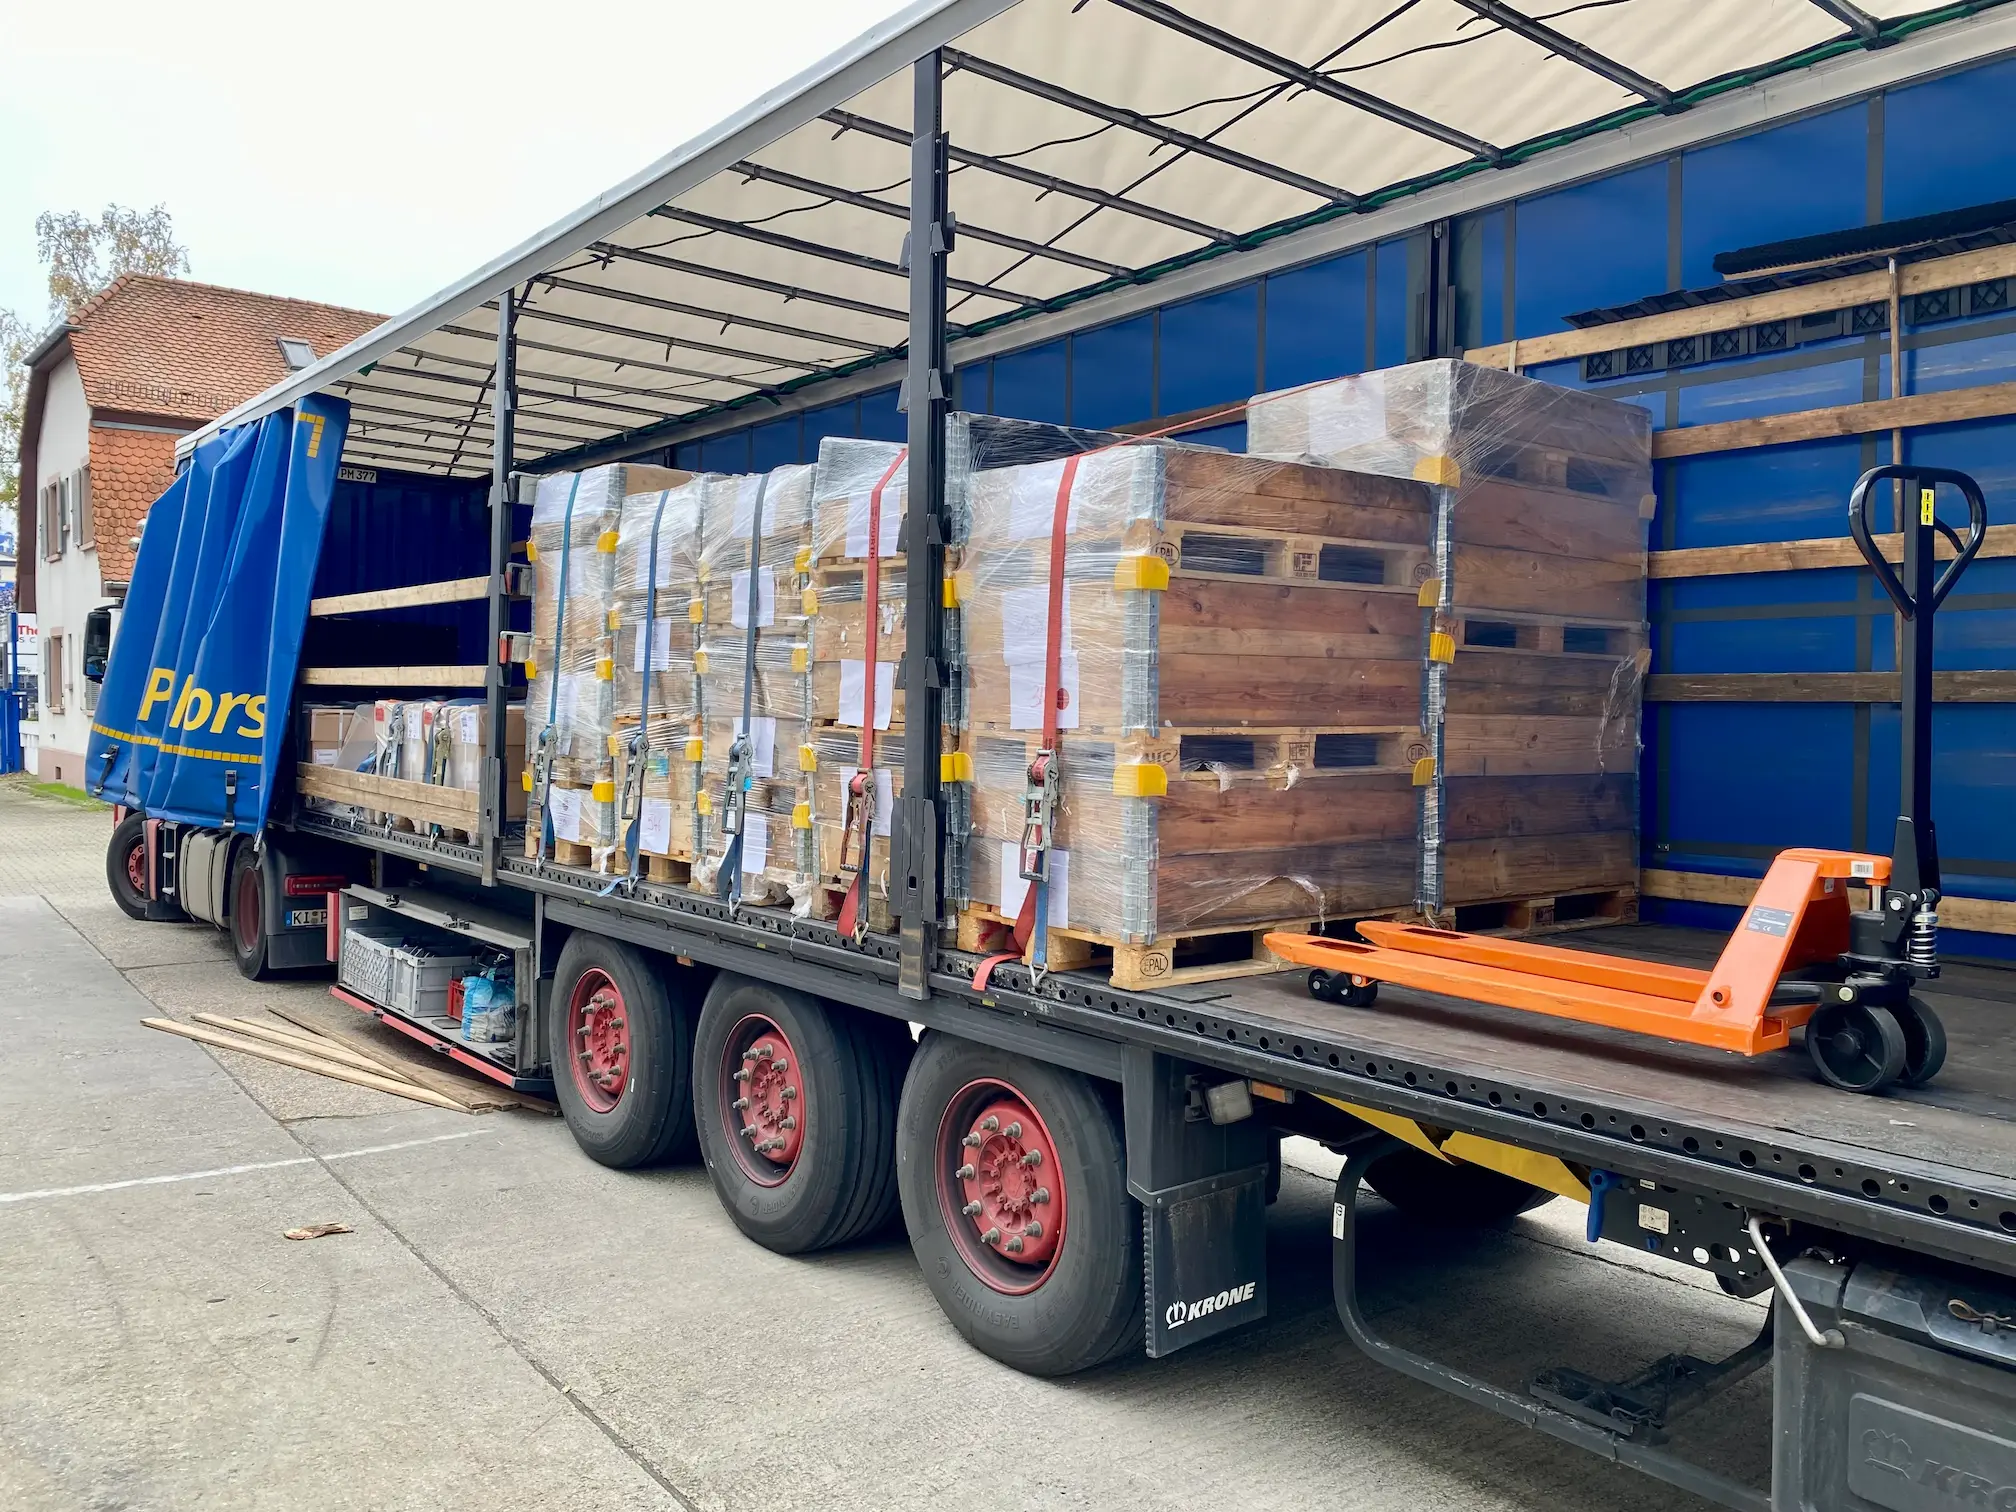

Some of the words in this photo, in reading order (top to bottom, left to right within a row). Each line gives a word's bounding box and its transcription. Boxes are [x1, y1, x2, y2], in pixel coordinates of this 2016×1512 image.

[340, 468, 354, 479] PM
[356, 470, 375, 482] 377
[293, 911, 309, 925] KI
[1187, 1281, 1256, 1322] KRONE
